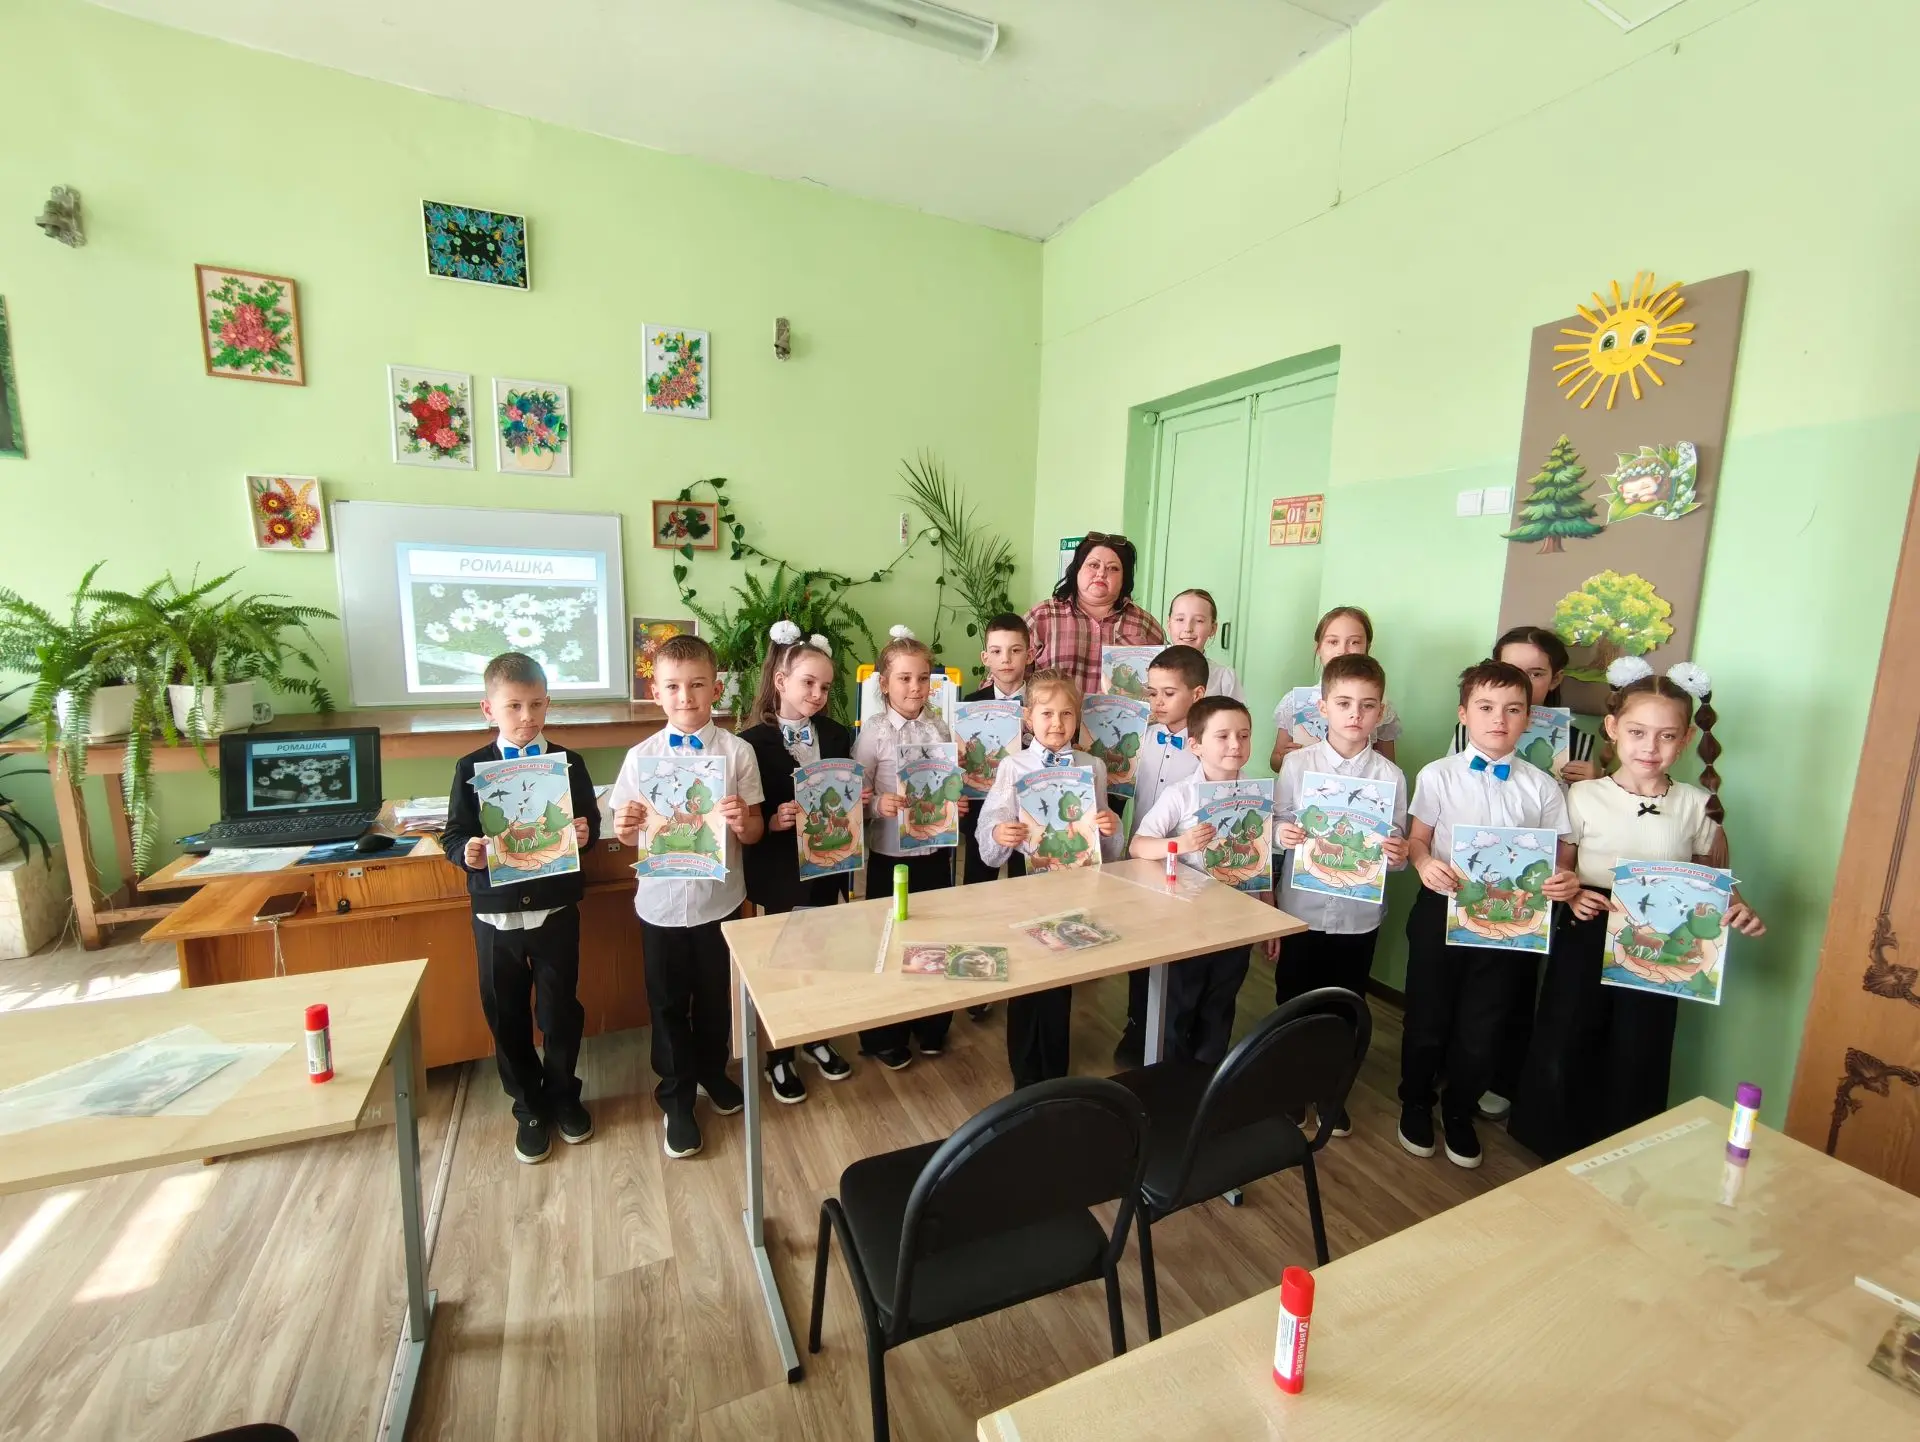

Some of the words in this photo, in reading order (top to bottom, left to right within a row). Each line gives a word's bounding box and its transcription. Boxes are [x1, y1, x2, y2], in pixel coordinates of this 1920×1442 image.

[459, 558, 554, 575] РОМАШКА
[276, 741, 327, 752] РОМАШКА
[1295, 1332, 1307, 1375] BRAUBERG
